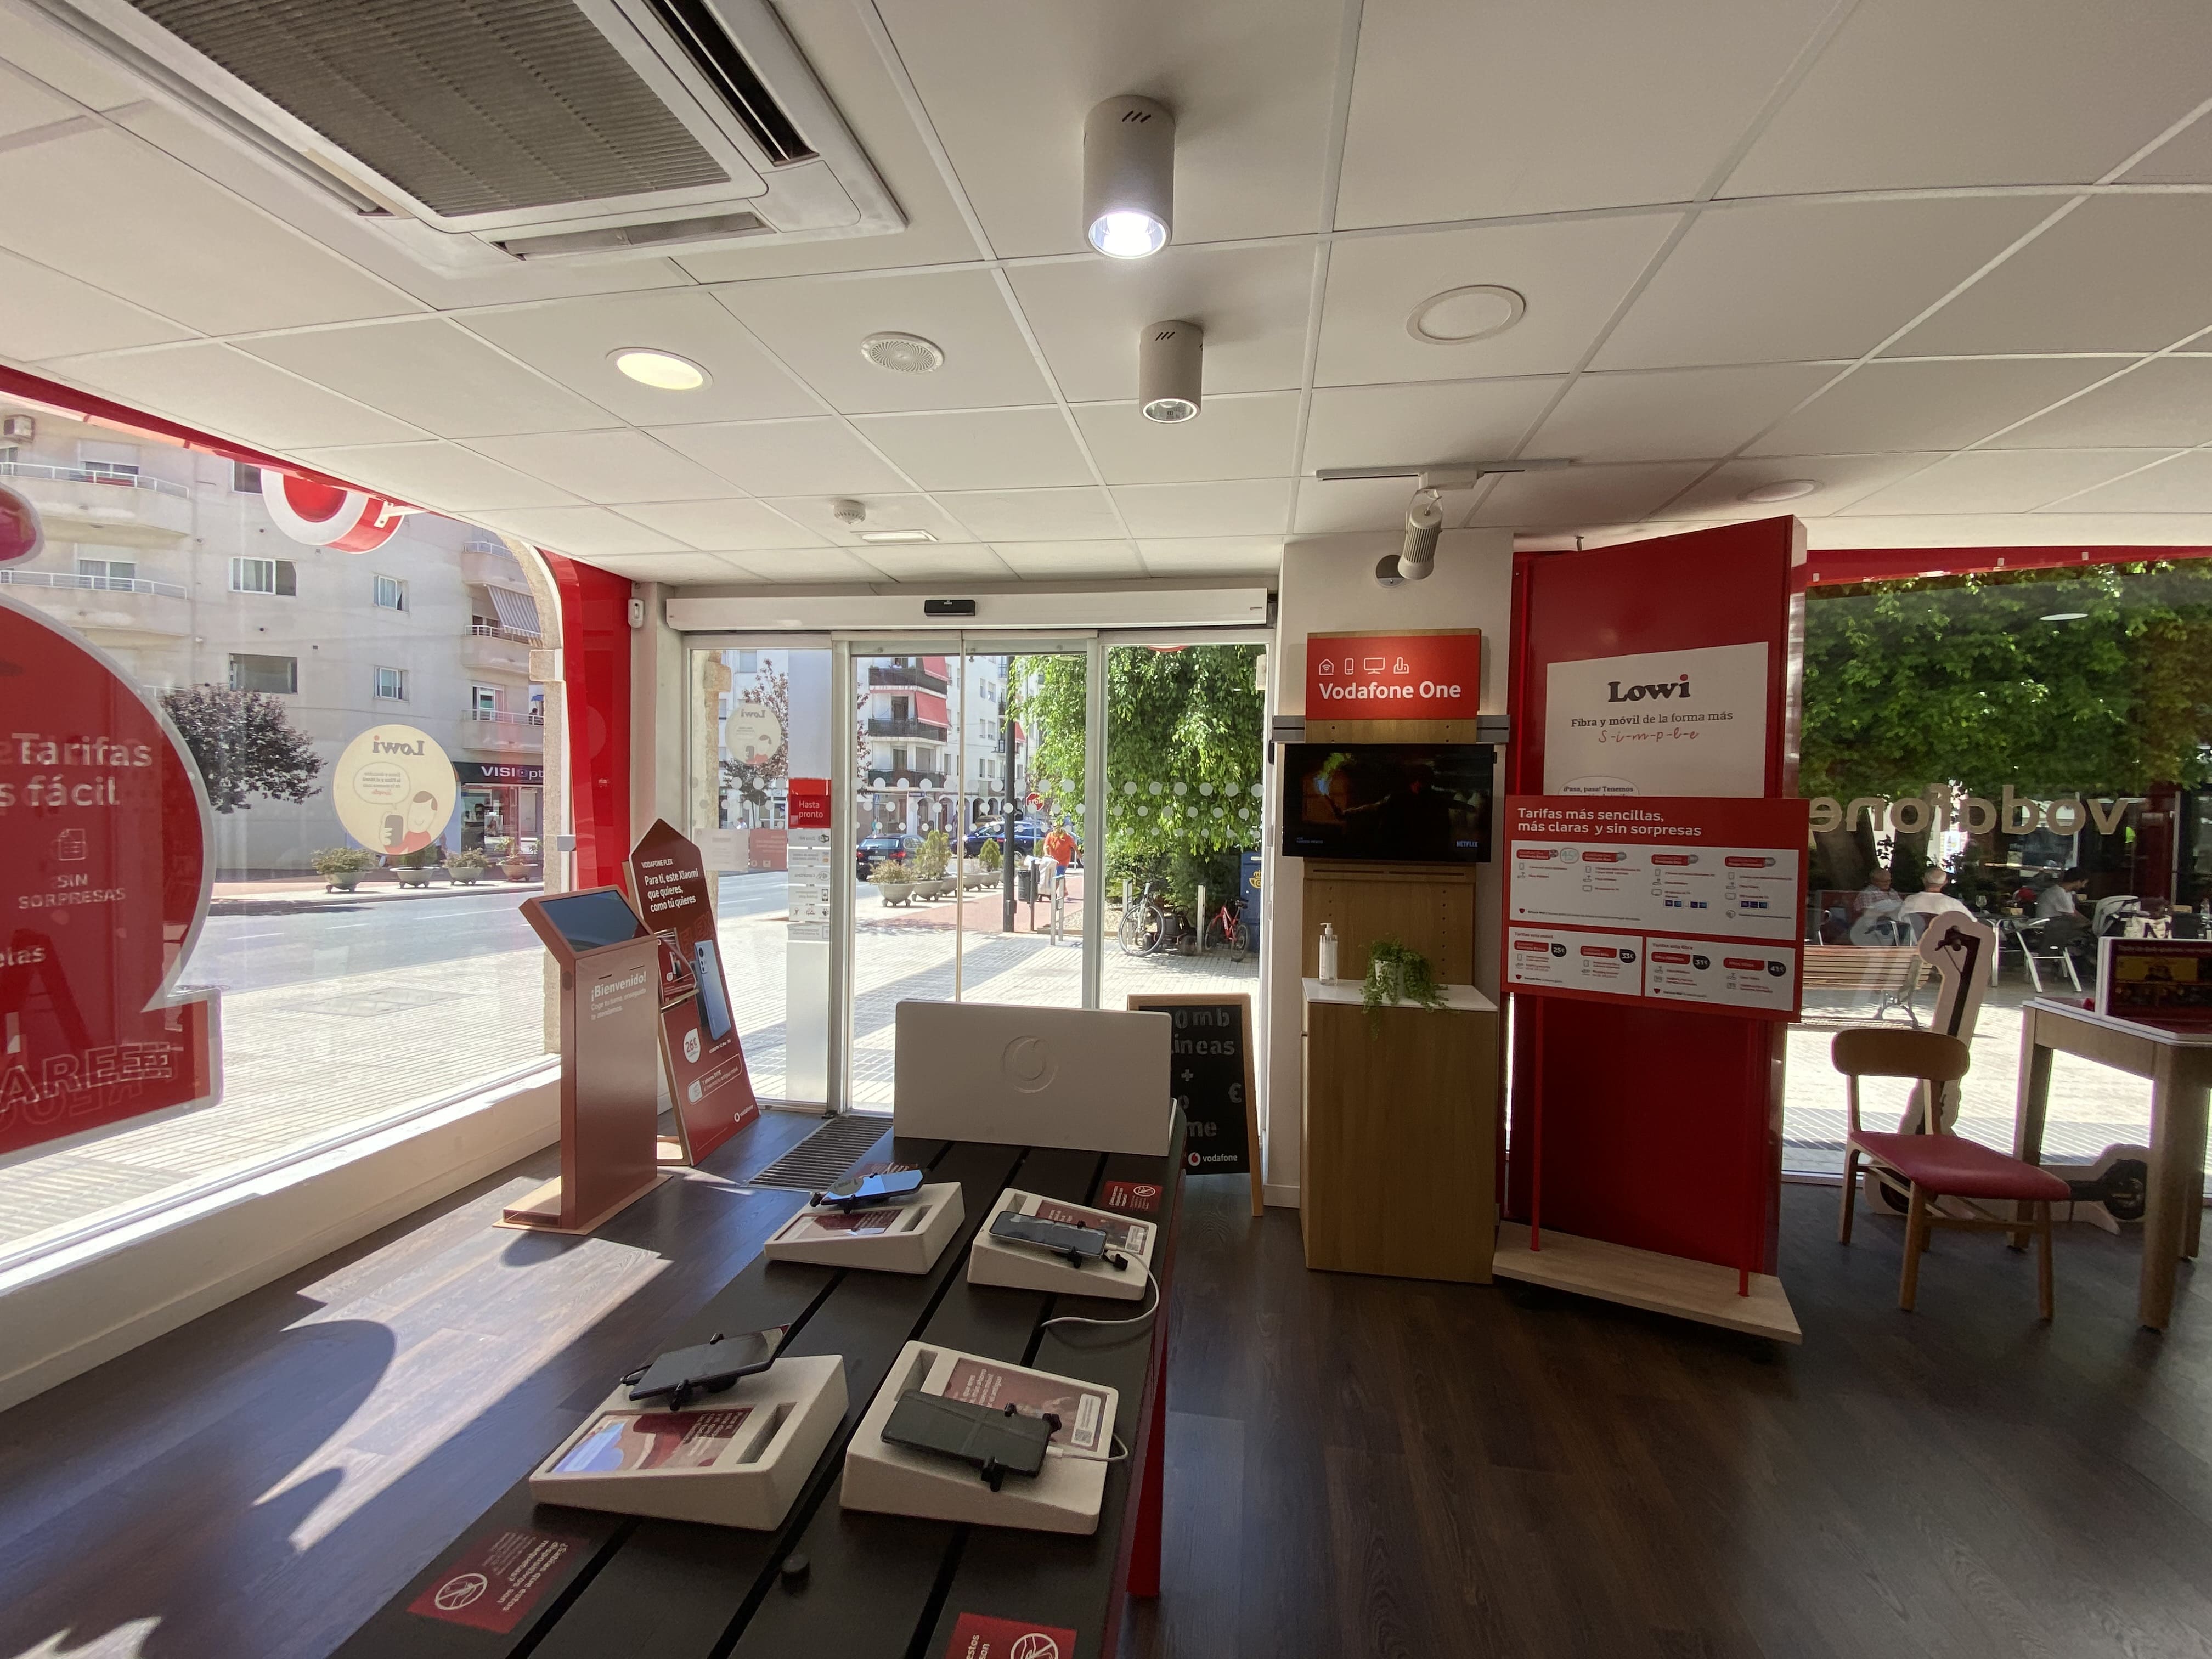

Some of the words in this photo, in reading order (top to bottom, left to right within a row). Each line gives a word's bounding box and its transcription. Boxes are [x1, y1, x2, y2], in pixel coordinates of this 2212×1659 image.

[1318, 682, 1414, 699] Vodafone
[1419, 681, 1462, 698] One
[1607, 674, 1691, 702] Lowi
[1571, 719, 1597, 727] Fibra
[1609, 715, 1639, 725] móvil
[1643, 715, 1656, 724] de
[1658, 714, 1668, 723] la
[1671, 713, 1705, 723] forma
[1707, 711, 1733, 721] más
[12, 733, 153, 766] Tarifas
[27, 774, 121, 806] fácil
[799, 800, 820, 809] Hasta
[1517, 808, 1562, 819] Tarifas
[1566, 808, 1594, 820] más
[1597, 809, 1664, 822] sencillas,
[1518, 821, 1545, 832] más
[1548, 822, 1589, 833] claras
[1595, 825, 1604, 836] y
[1606, 823, 1627, 834] sin
[1630, 826, 1702, 837] sorpresas
[641, 860, 663, 868] VODAFONE
[58, 874, 88, 888] SIN
[644, 876, 659, 886] Para
[665, 872, 679, 882] este
[679, 868, 699, 880] Xiaomi
[18, 887, 126, 910] SORPRESAS
[647, 889, 660, 901] que
[660, 885, 684, 899] quieres,
[650, 901, 668, 912] como
[667, 898, 675, 909] tú
[675, 895, 696, 909] quieres
[591, 970, 646, 1002] ¡Bienvenido!
[591, 1002, 604, 1011] Coge
[685, 1037, 698, 1053] 26€
[1172, 1033, 1235, 1056] ineas
[1203, 1154, 1238, 1163] vodafone
[524, 1572, 541, 1588] que
[497, 1588, 514, 1603] son
[502, 1588, 526, 1611] estos
